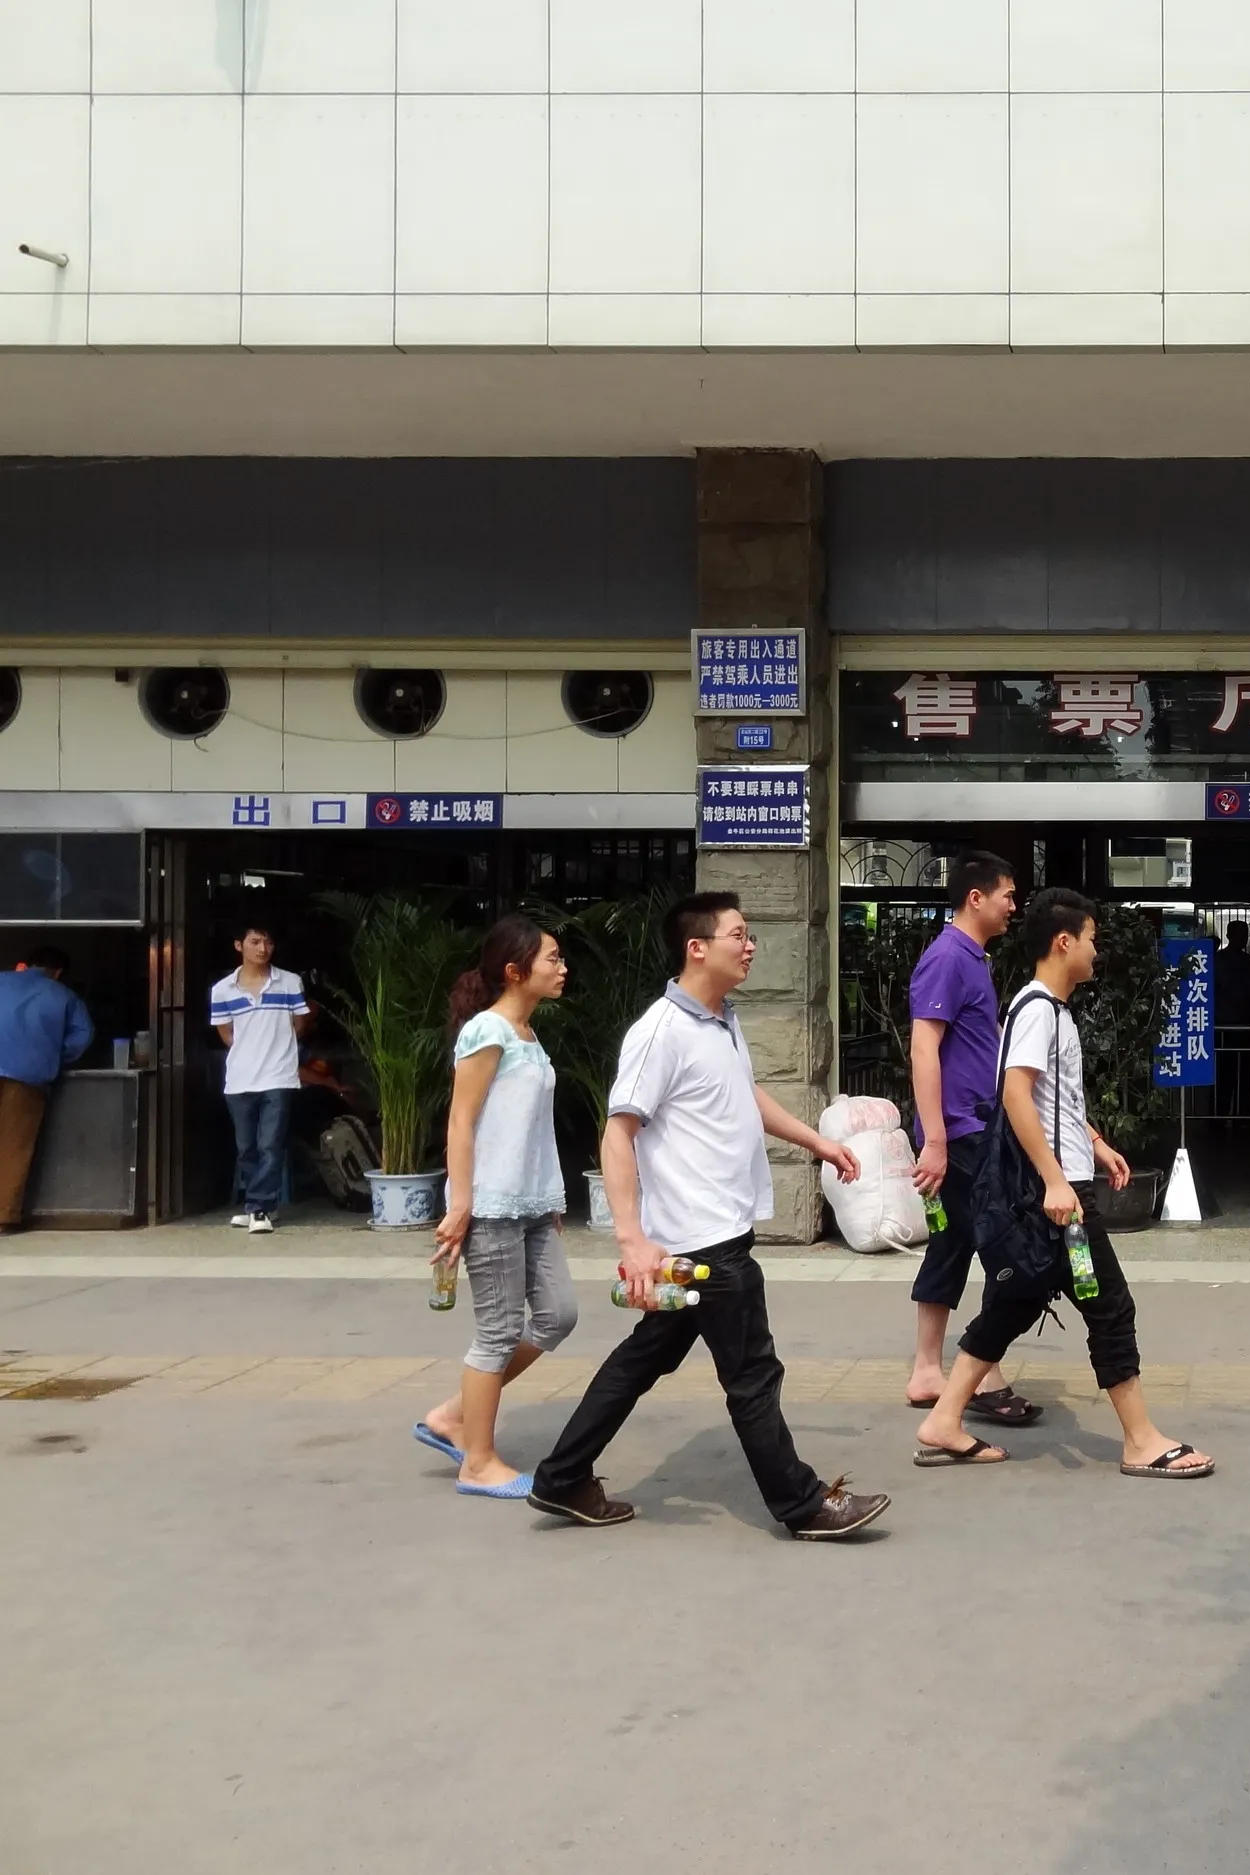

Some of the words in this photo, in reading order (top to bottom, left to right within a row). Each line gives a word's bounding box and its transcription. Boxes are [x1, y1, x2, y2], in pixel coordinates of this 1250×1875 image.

[701, 639, 797, 660] 旅客专用出入通道
[700, 664, 798, 686] 严禁驾乘人员进出
[707, 780, 798, 797] 不要理睬票串串
[232, 795, 347, 827] 出口
[409, 799, 494, 823] 禁止吸烟
[702, 805, 802, 822] 请您到站内窗口购票
